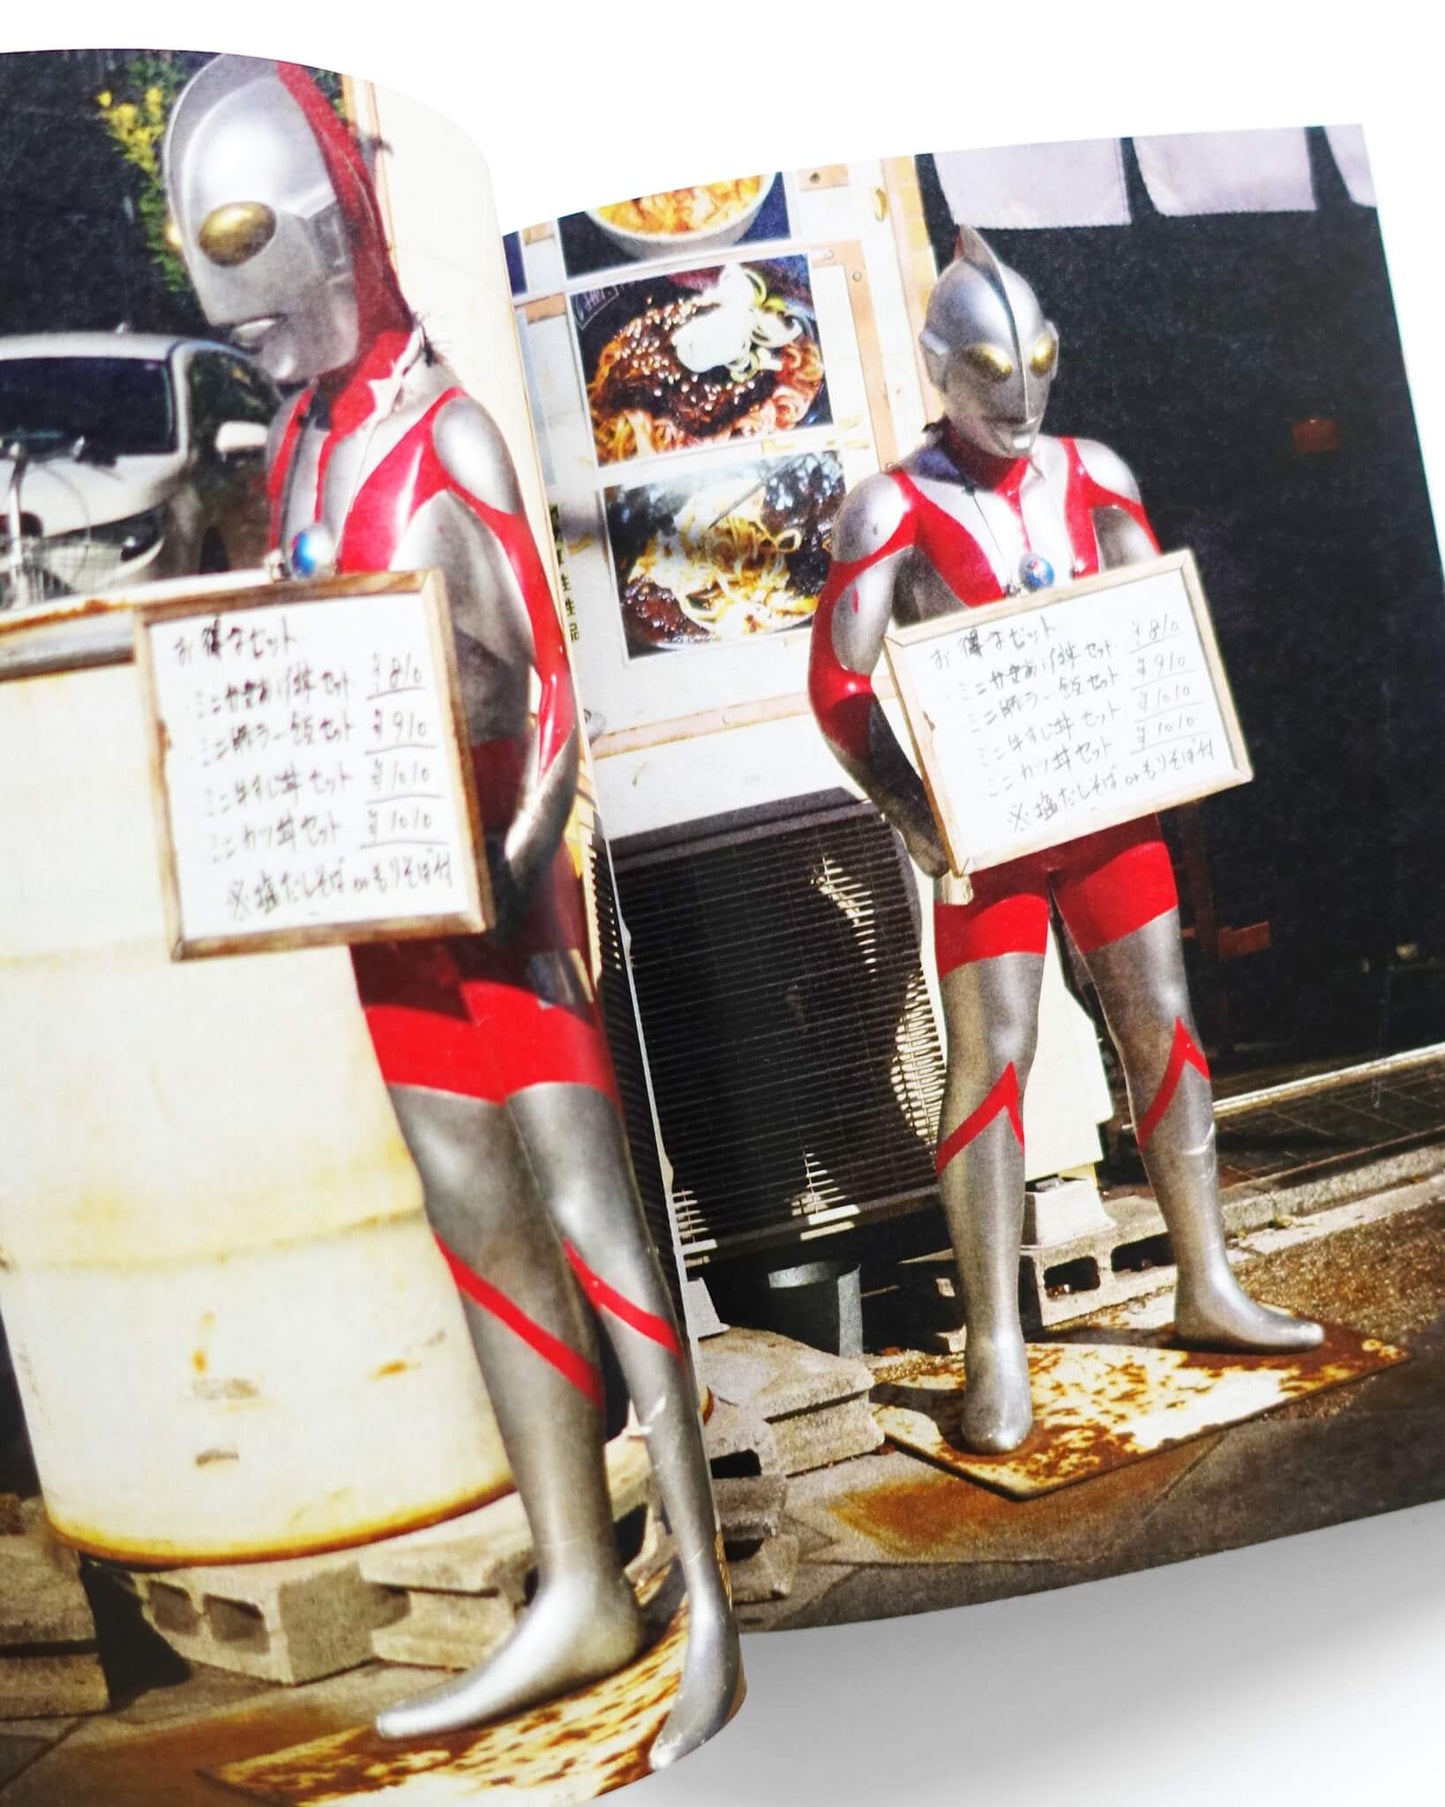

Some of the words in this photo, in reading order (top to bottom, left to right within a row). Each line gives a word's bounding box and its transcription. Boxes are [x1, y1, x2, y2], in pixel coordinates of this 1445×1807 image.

[1137, 653, 1187, 679] ¥910
[1138, 685, 1192, 715] ¥1010
[372, 709, 428, 743] ¥910
[1137, 716, 1195, 745] ¥1010
[371, 760, 431, 789] ¥1010
[369, 809, 433, 843] ¥1010
